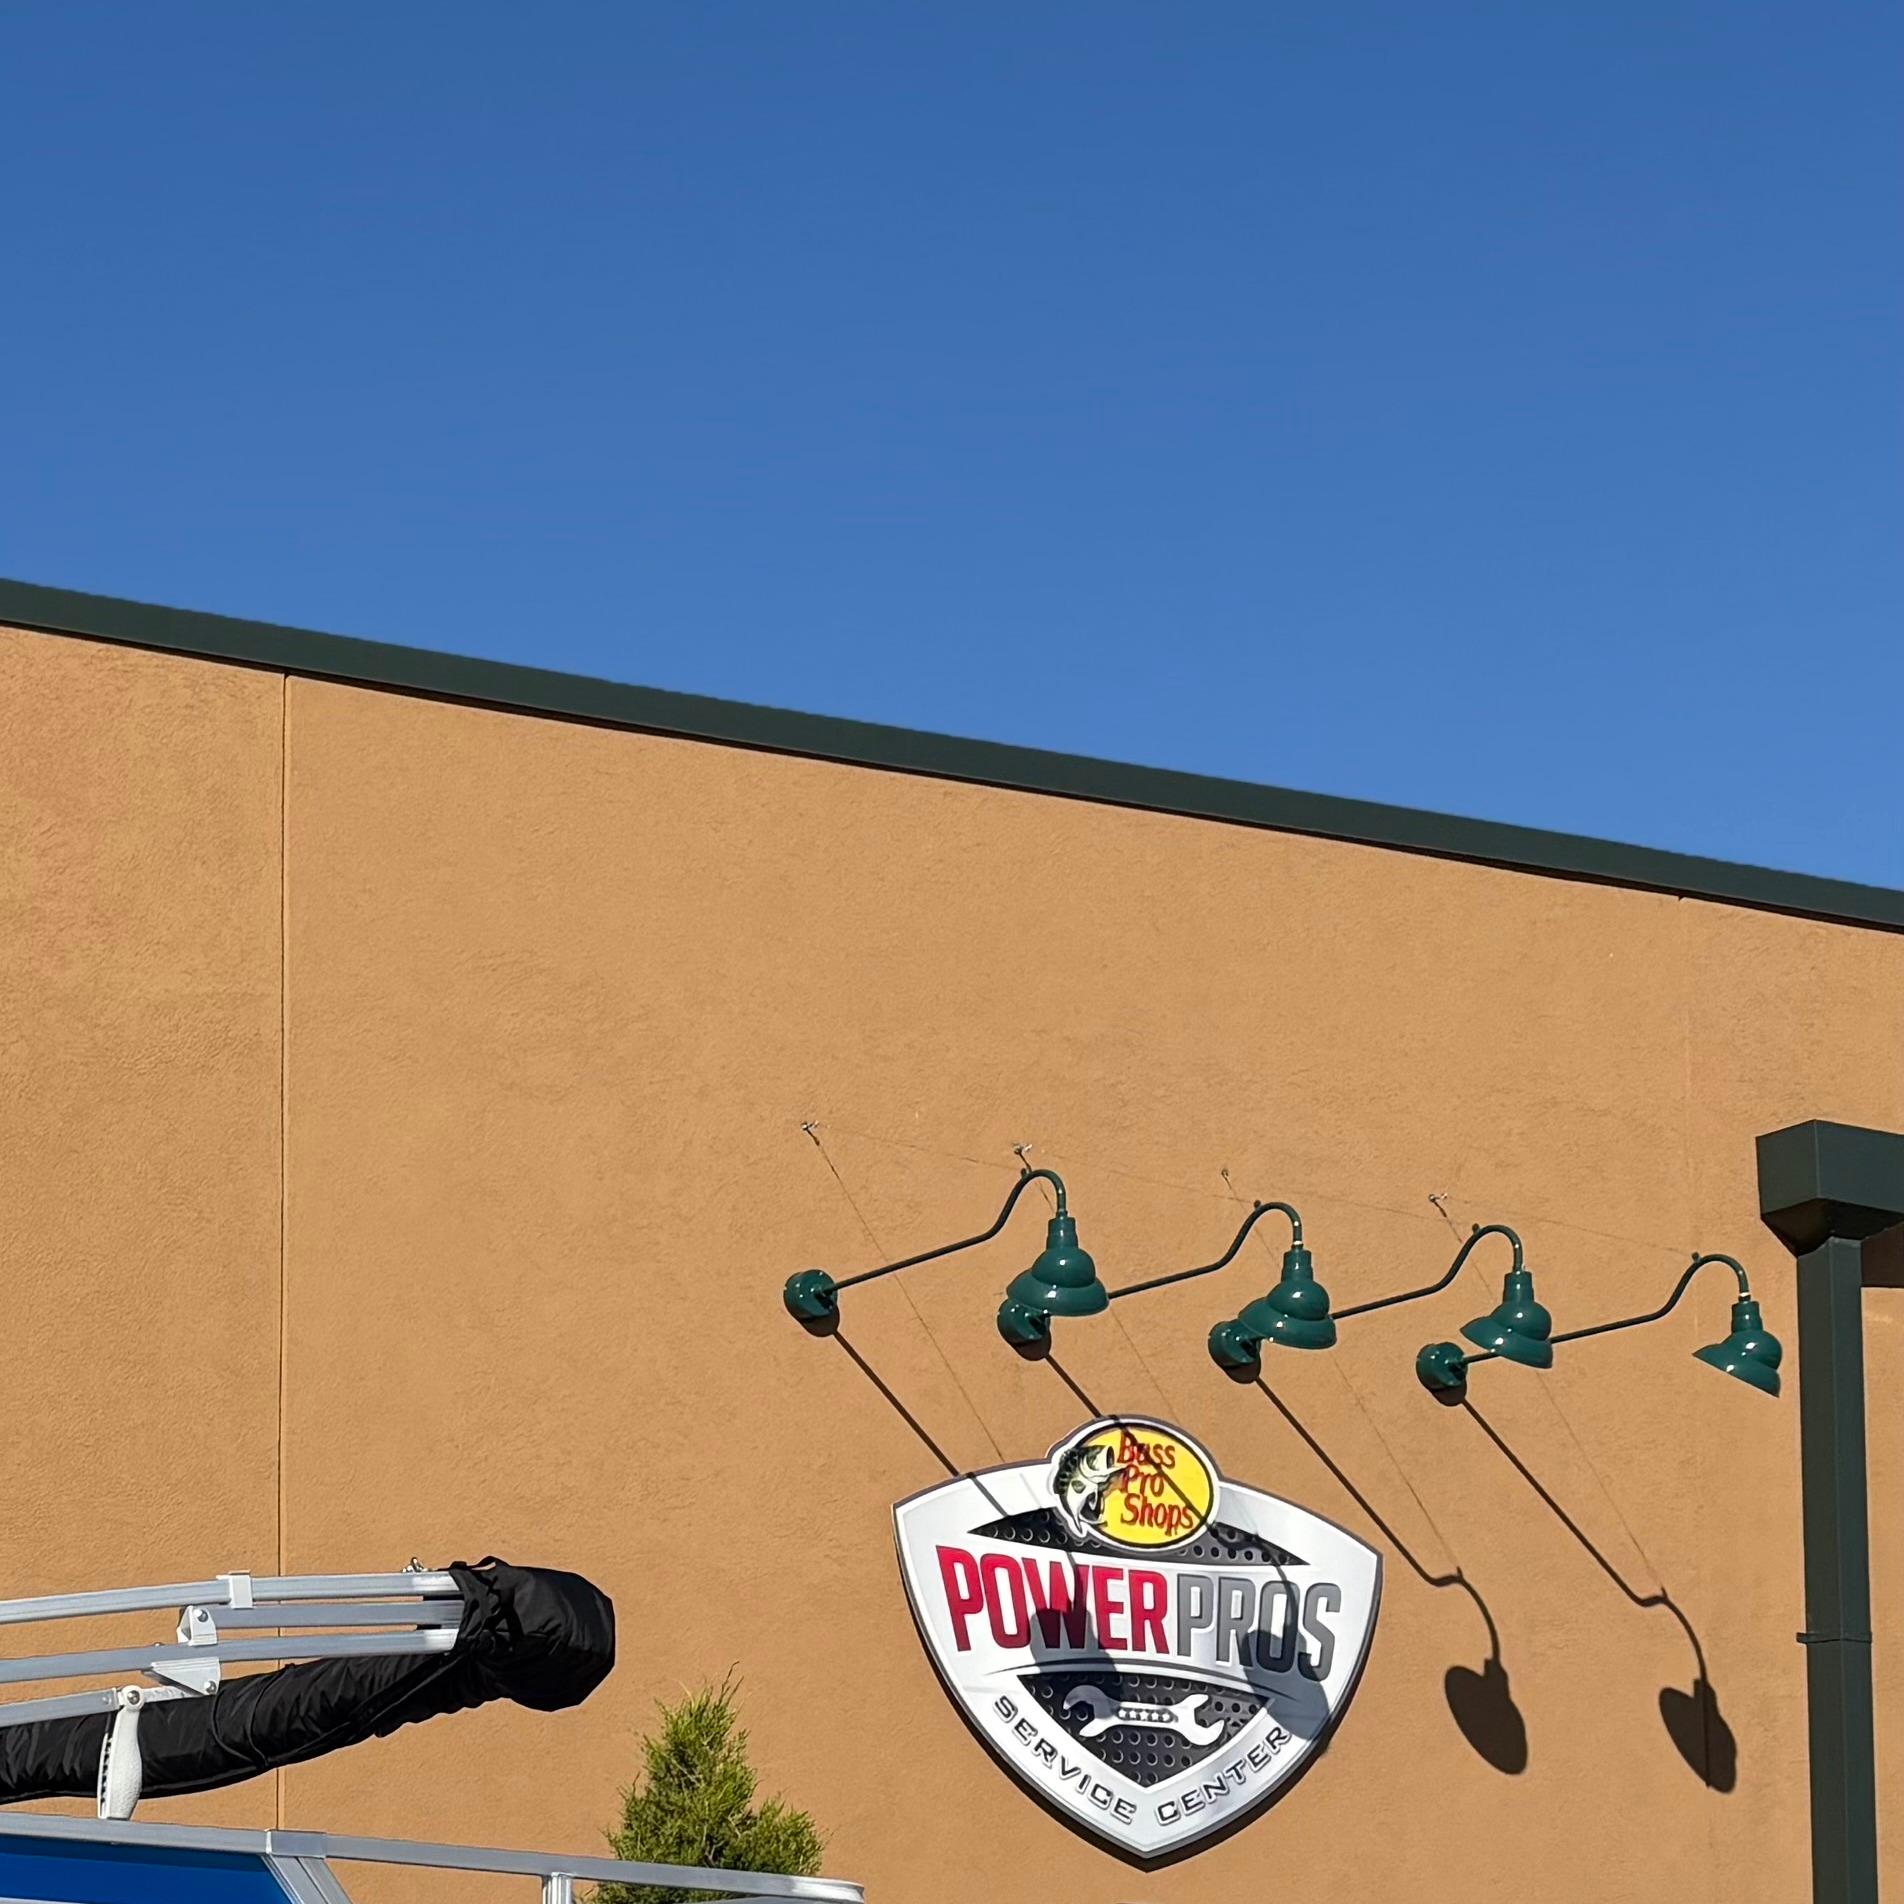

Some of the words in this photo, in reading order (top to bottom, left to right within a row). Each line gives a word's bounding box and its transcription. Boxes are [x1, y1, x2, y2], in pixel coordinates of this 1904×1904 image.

[1117, 1430, 1176, 1469] Bass
[1120, 1463, 1165, 1497] Pro
[1120, 1493, 1193, 1536] Shops
[992, 1694, 1137, 1824] SERVICE
[1155, 1725, 1291, 1826] CENTER
